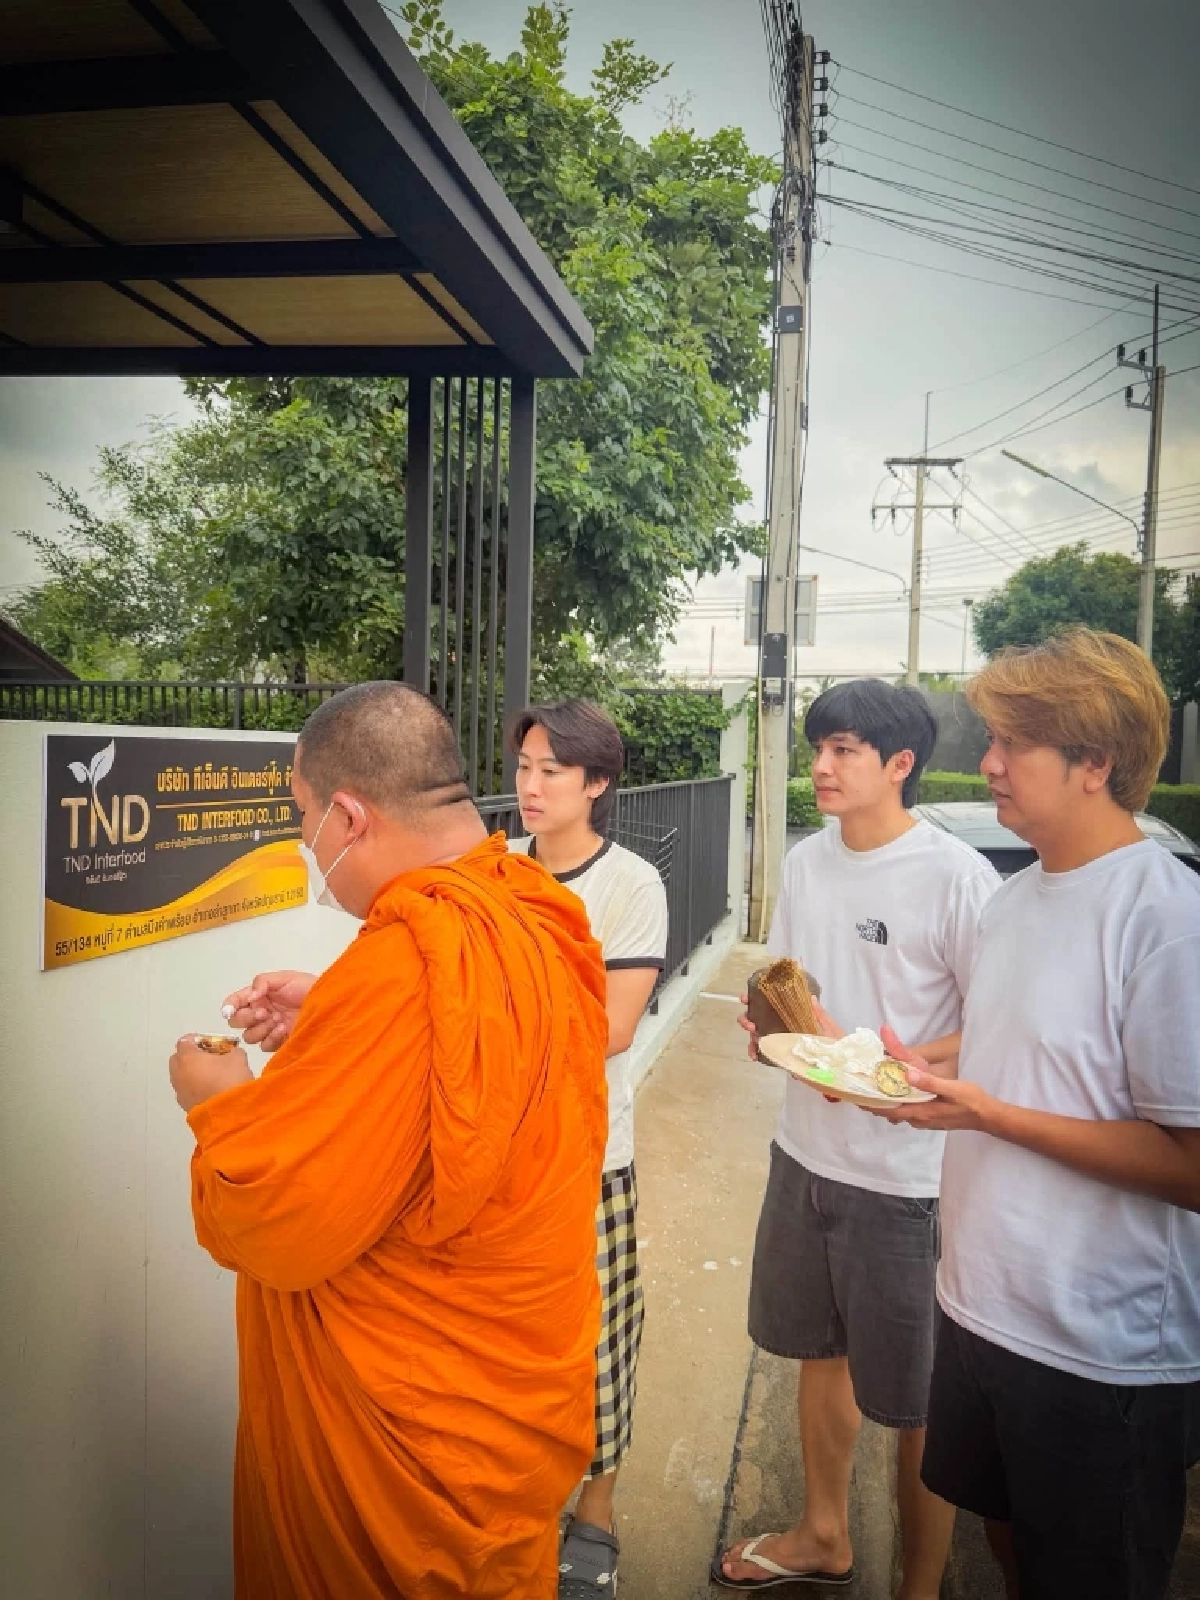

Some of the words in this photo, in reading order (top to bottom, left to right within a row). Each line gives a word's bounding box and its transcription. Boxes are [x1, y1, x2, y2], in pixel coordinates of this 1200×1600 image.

[157, 766, 190, 792] บริษัท
[60, 794, 150, 849] TND
[177, 813, 199, 832] TND
[202, 808, 254, 830] INTERFOOD
[276, 805, 293, 823] LTD.
[62, 855, 91, 873] TND
[94, 847, 146, 870] Interfood
[55, 936, 92, 956] 55/134
[116, 928, 123, 942] 7
